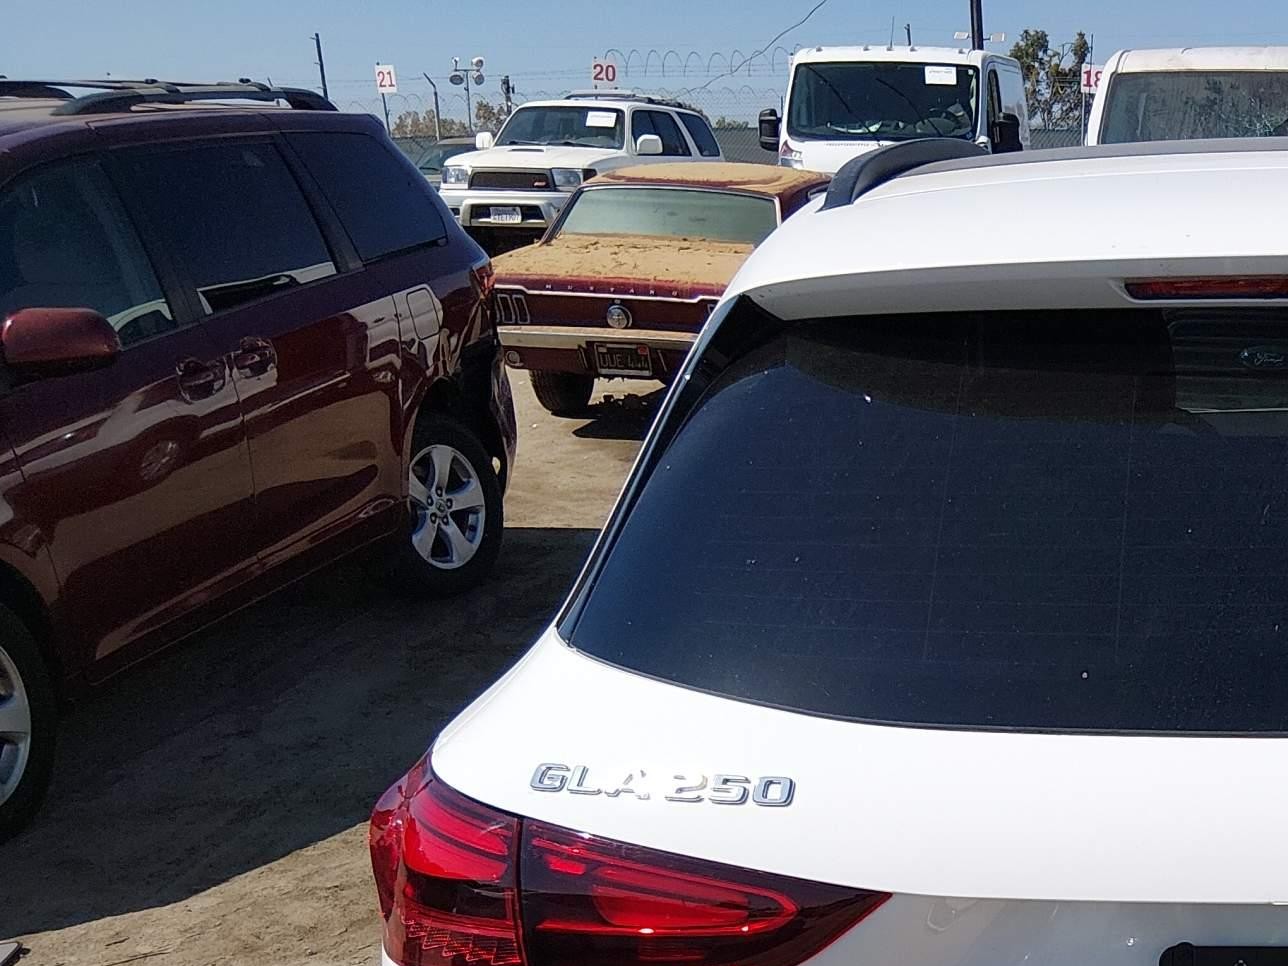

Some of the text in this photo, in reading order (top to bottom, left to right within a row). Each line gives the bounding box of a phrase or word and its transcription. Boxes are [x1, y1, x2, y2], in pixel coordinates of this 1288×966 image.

[377, 70, 396, 88] 21
[593, 64, 616, 82] 20
[545, 284, 678, 296] MUSTANG
[530, 762, 797, 807] GLA 250
